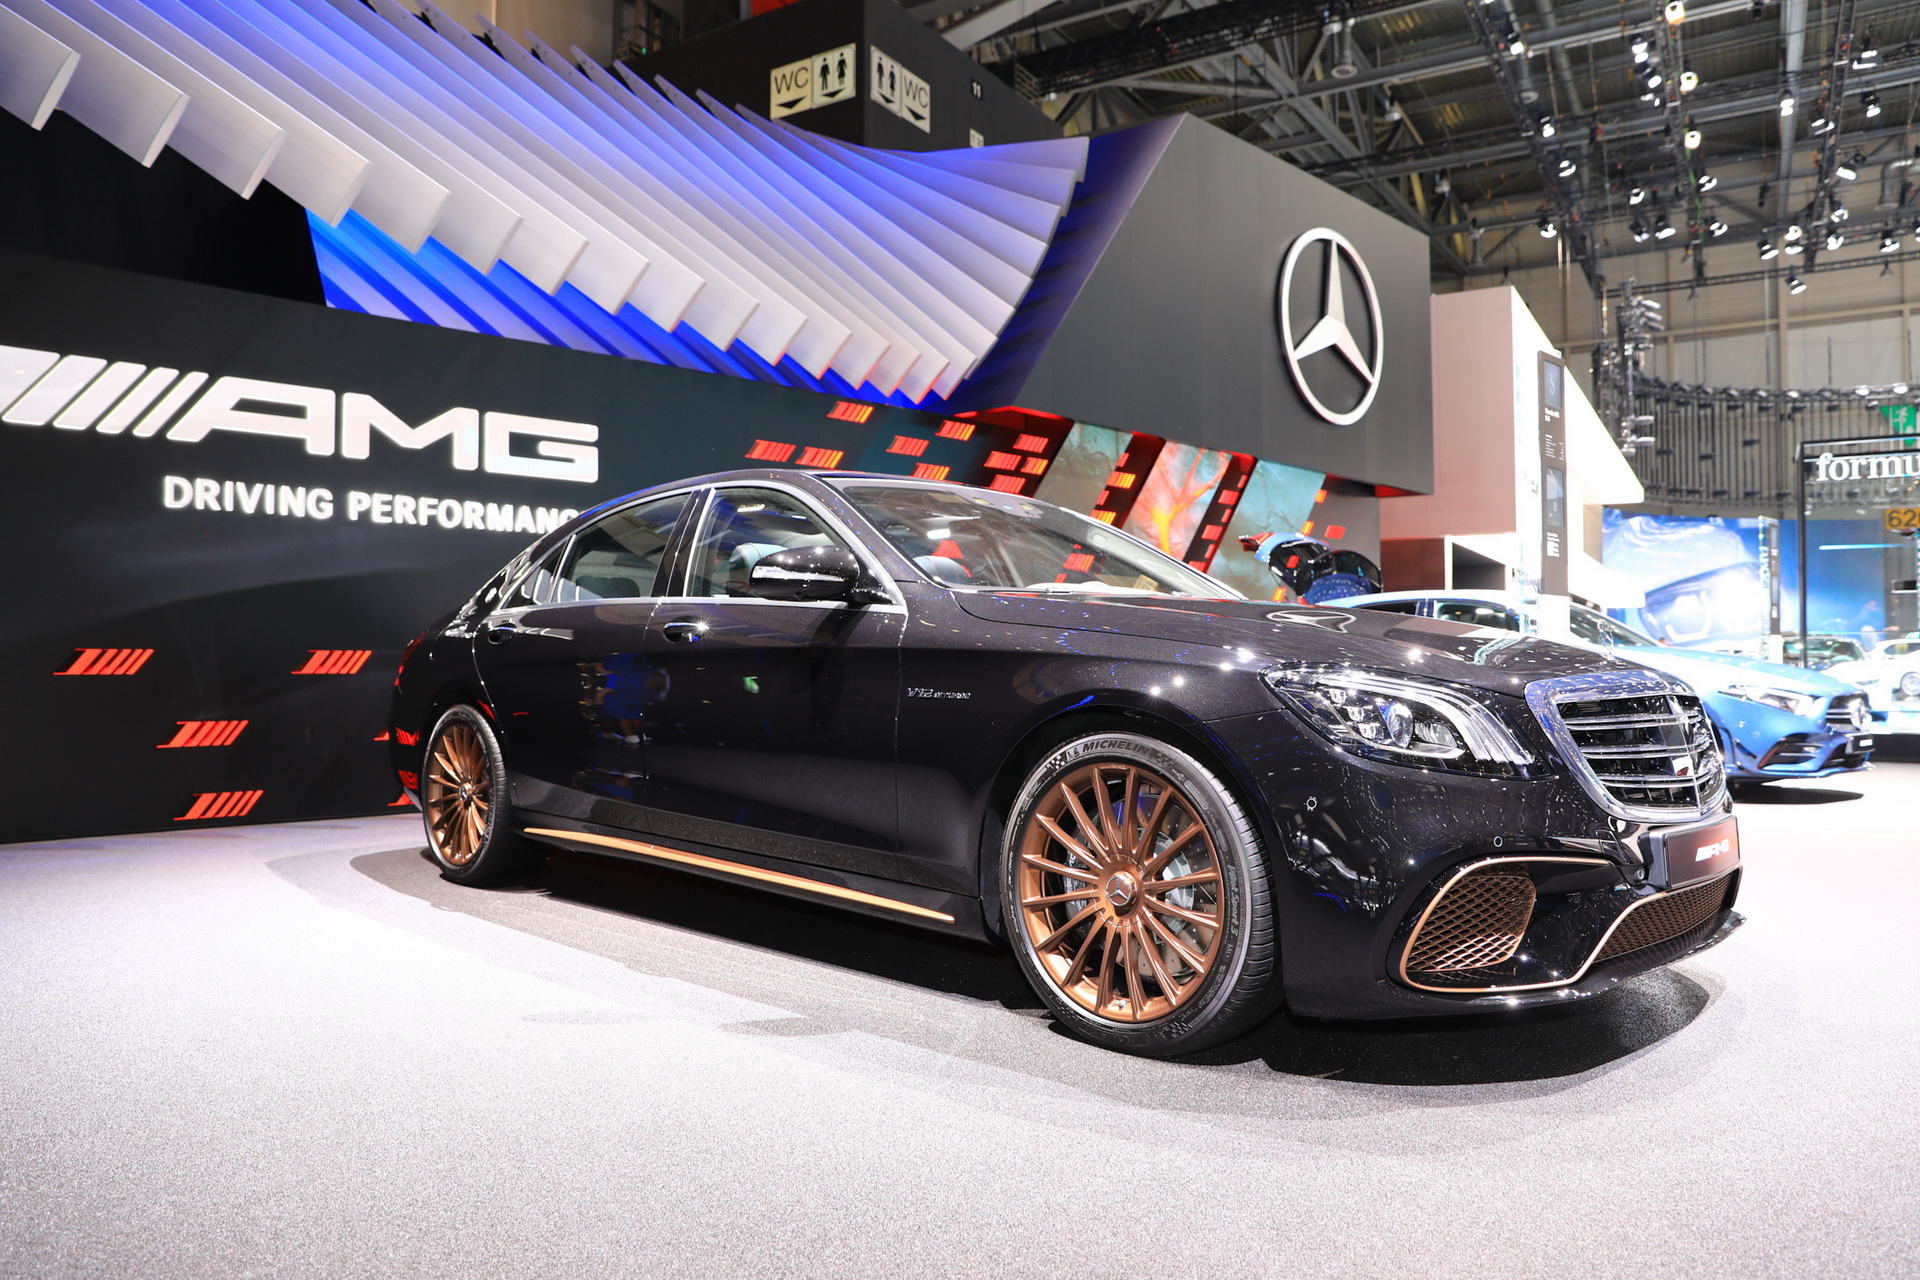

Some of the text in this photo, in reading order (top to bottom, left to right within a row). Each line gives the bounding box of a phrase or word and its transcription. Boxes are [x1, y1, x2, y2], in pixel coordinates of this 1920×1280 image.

[774, 66, 809, 94] WC
[903, 75, 928, 109] WC
[166, 376, 599, 483] AMG
[164, 476, 582, 534] DRIVING PERFORMANC
[1888, 509, 1920, 528] 62
[1082, 739, 1150, 756] MICHELIN
